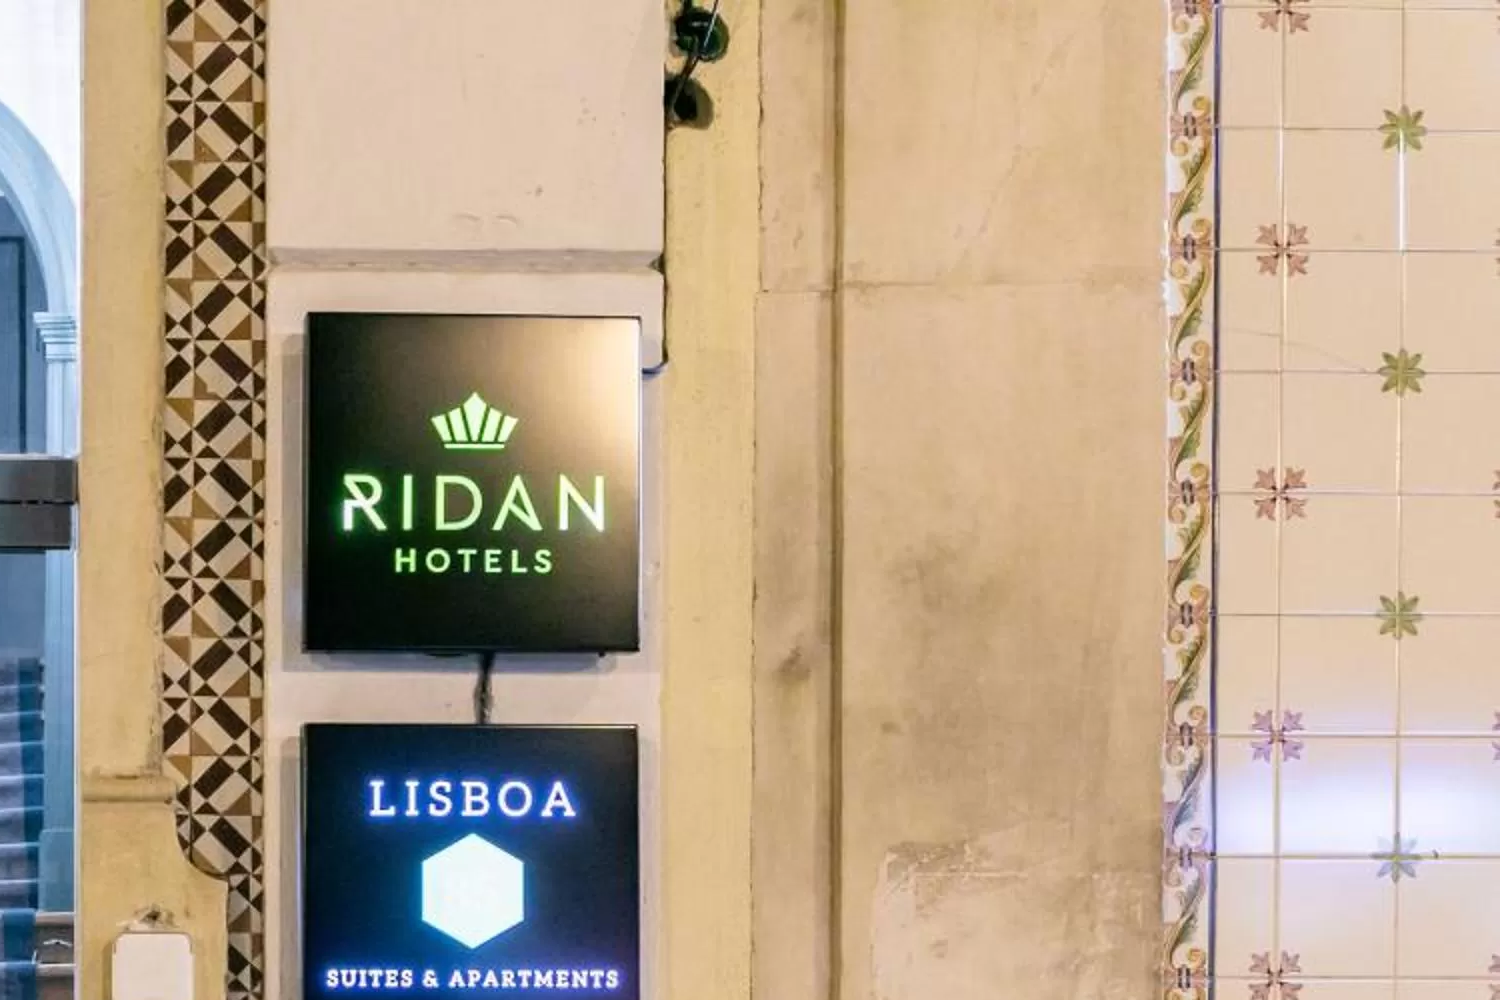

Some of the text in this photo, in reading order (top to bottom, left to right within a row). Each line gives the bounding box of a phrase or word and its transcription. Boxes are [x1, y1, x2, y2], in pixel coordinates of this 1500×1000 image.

[341, 473, 606, 532] RIDAN
[394, 548, 553, 573] HOTELS
[368, 779, 577, 818] LISBOA
[325, 968, 619, 989] SUITES & APARTMENTS
